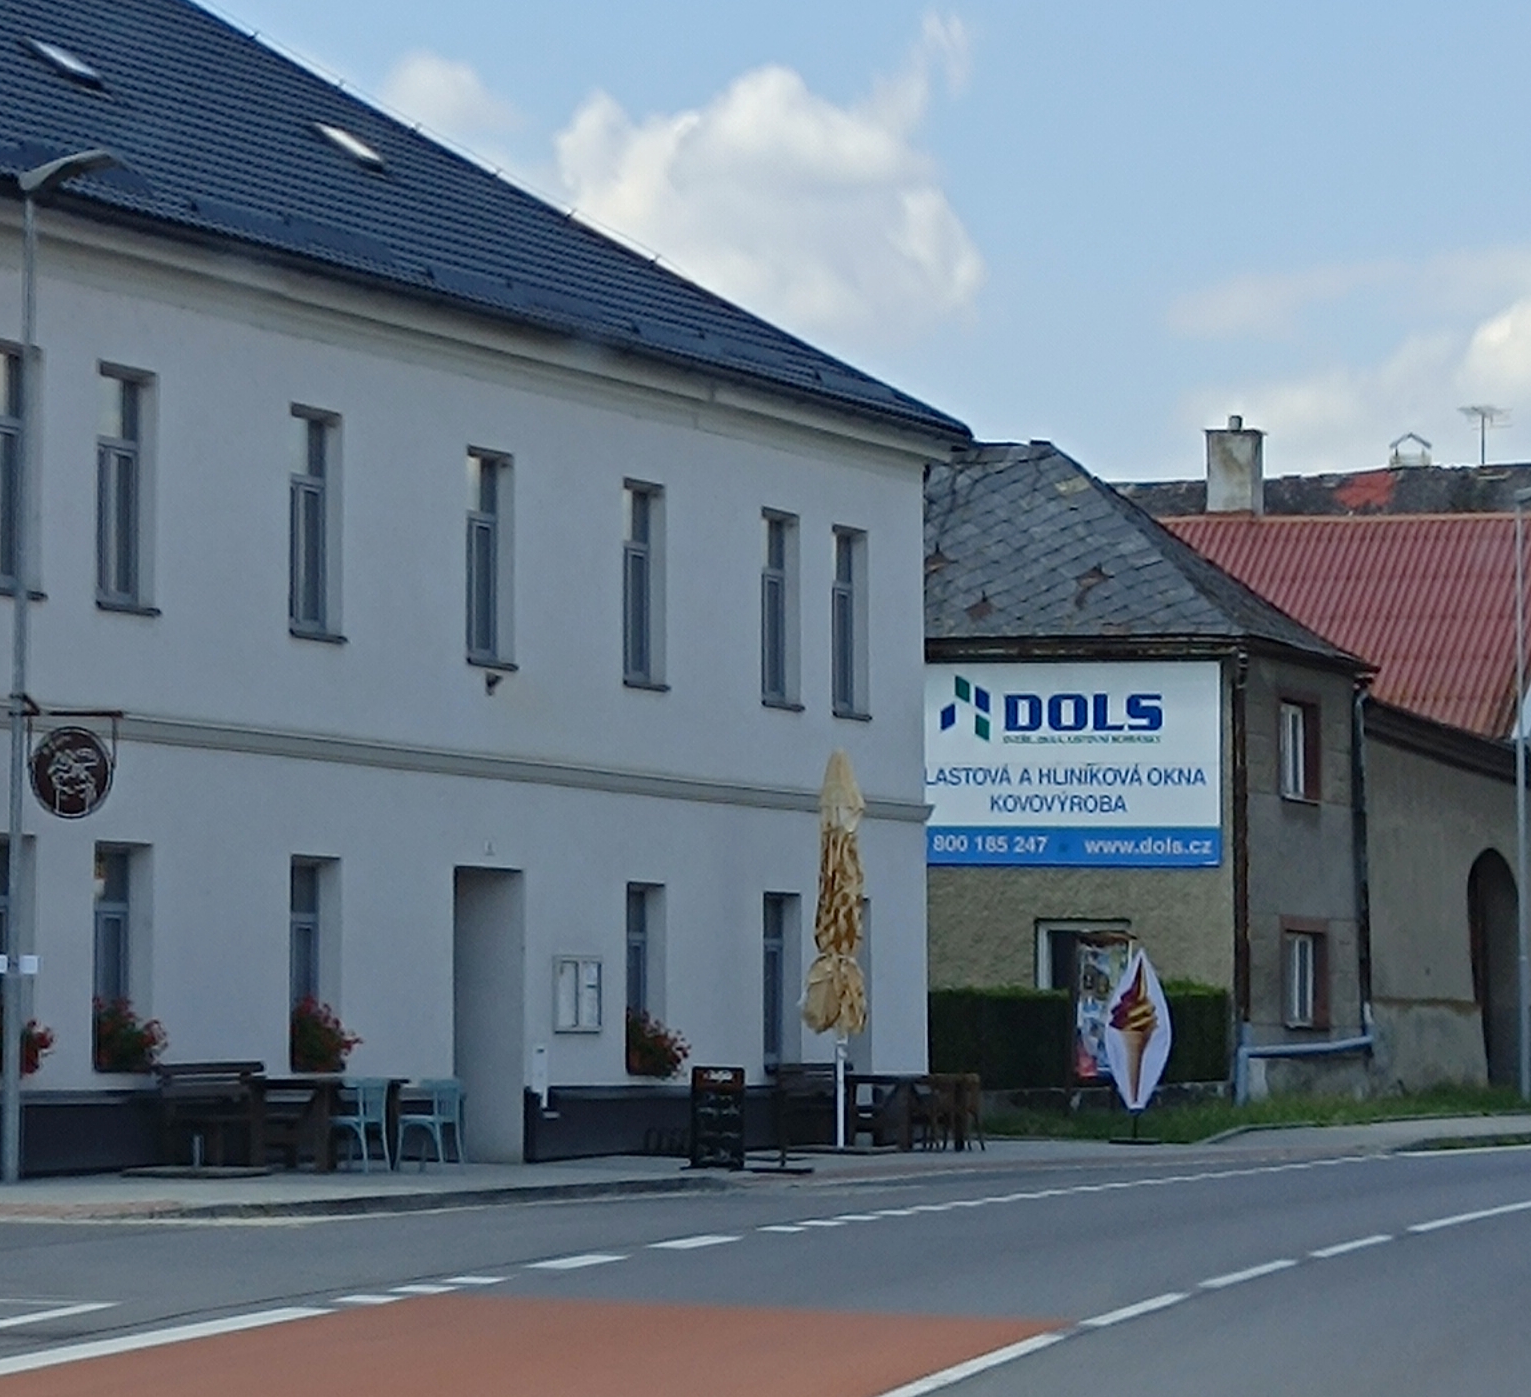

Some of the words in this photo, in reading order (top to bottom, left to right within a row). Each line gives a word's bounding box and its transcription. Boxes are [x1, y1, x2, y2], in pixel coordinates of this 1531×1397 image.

[1004, 693, 1163, 731] DOLS
[924, 764, 1012, 785] LASTOVÁ
[1019, 767, 1033, 785] A
[1038, 762, 1143, 786] HLINÍKOVÁ
[1147, 767, 1207, 786] OKNA
[990, 791, 1128, 813] KOVOVÝROBA
[932, 834, 968, 852] 800
[974, 835, 1009, 853] 185
[1013, 835, 1048, 853] 247
[1084, 836, 1213, 854] www.dols.cz
